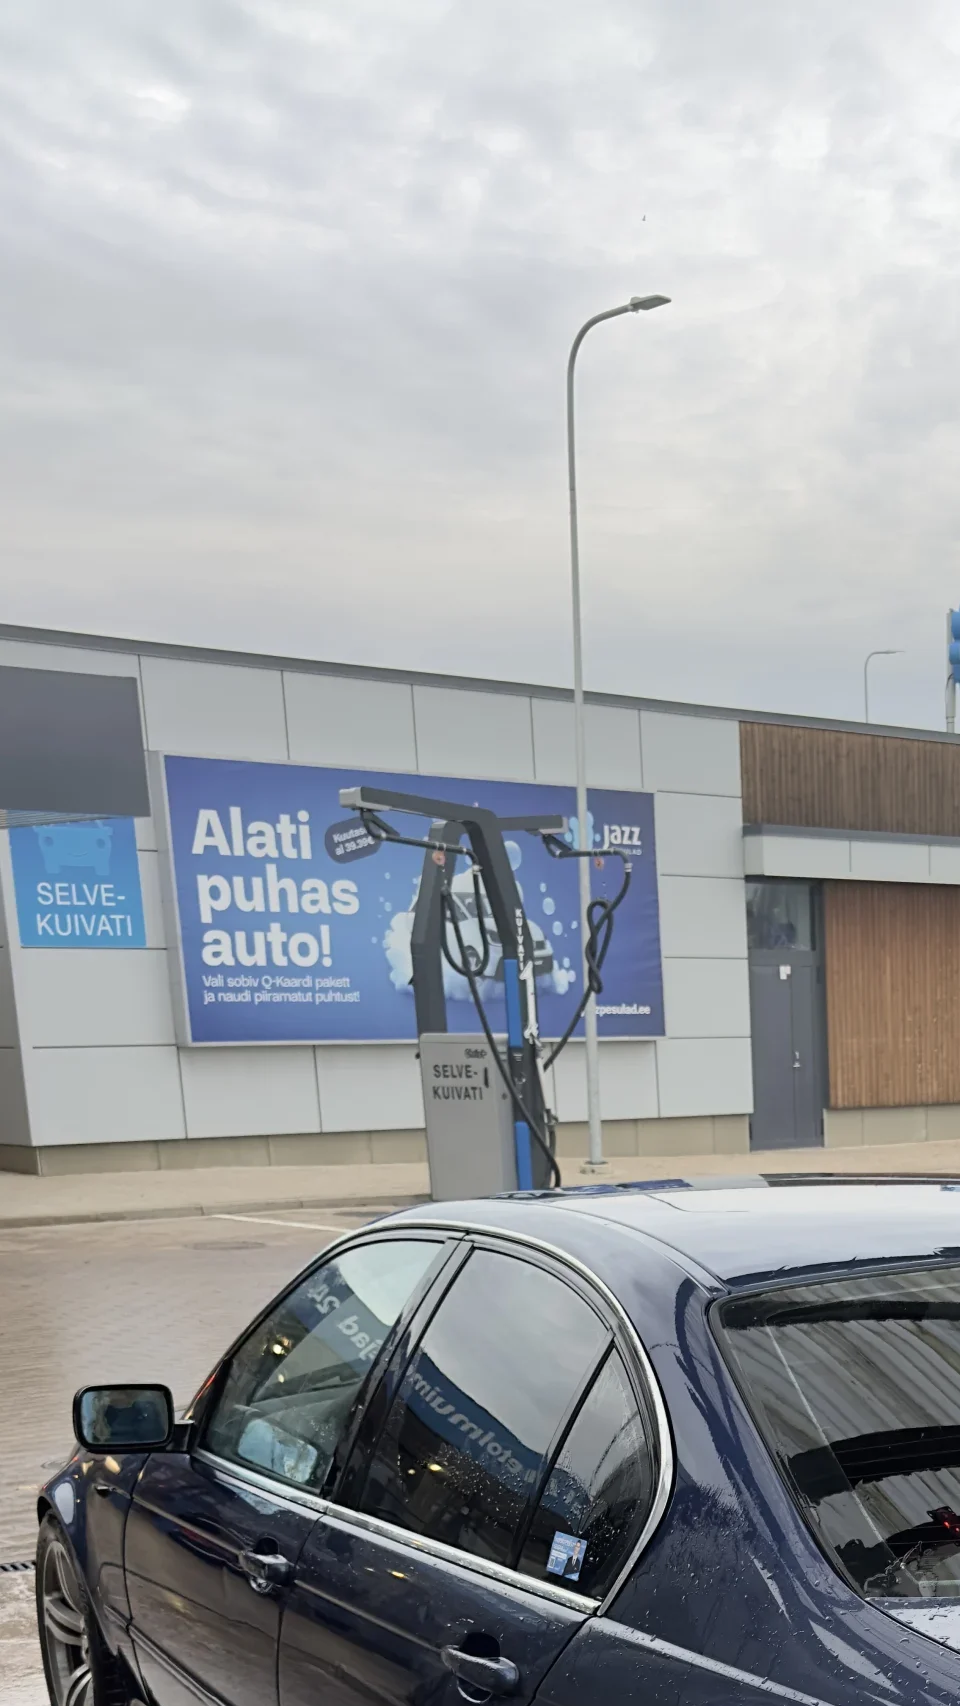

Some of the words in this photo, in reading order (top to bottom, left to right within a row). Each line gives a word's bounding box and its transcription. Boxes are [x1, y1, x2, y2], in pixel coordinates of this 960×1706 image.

[192, 807, 312, 860] Alati
[603, 824, 642, 850] jazz
[36, 882, 126, 906] SELVE-
[197, 864, 360, 924] puhas
[36, 913, 133, 937] KUIVATI
[202, 923, 332, 967] auto!
[514, 908, 525, 971] KUIVATI
[202, 975, 224, 988] Vali
[227, 975, 259, 988] sobiv
[261, 976, 313, 989] Q-Kaardi
[315, 977, 350, 989] pakett
[203, 990, 215, 1005] ja
[218, 990, 251, 1002] naudi
[315, 991, 360, 1005] puhtust!
[433, 1064, 478, 1079] SELVE-
[432, 1086, 483, 1101] KUIVATI
